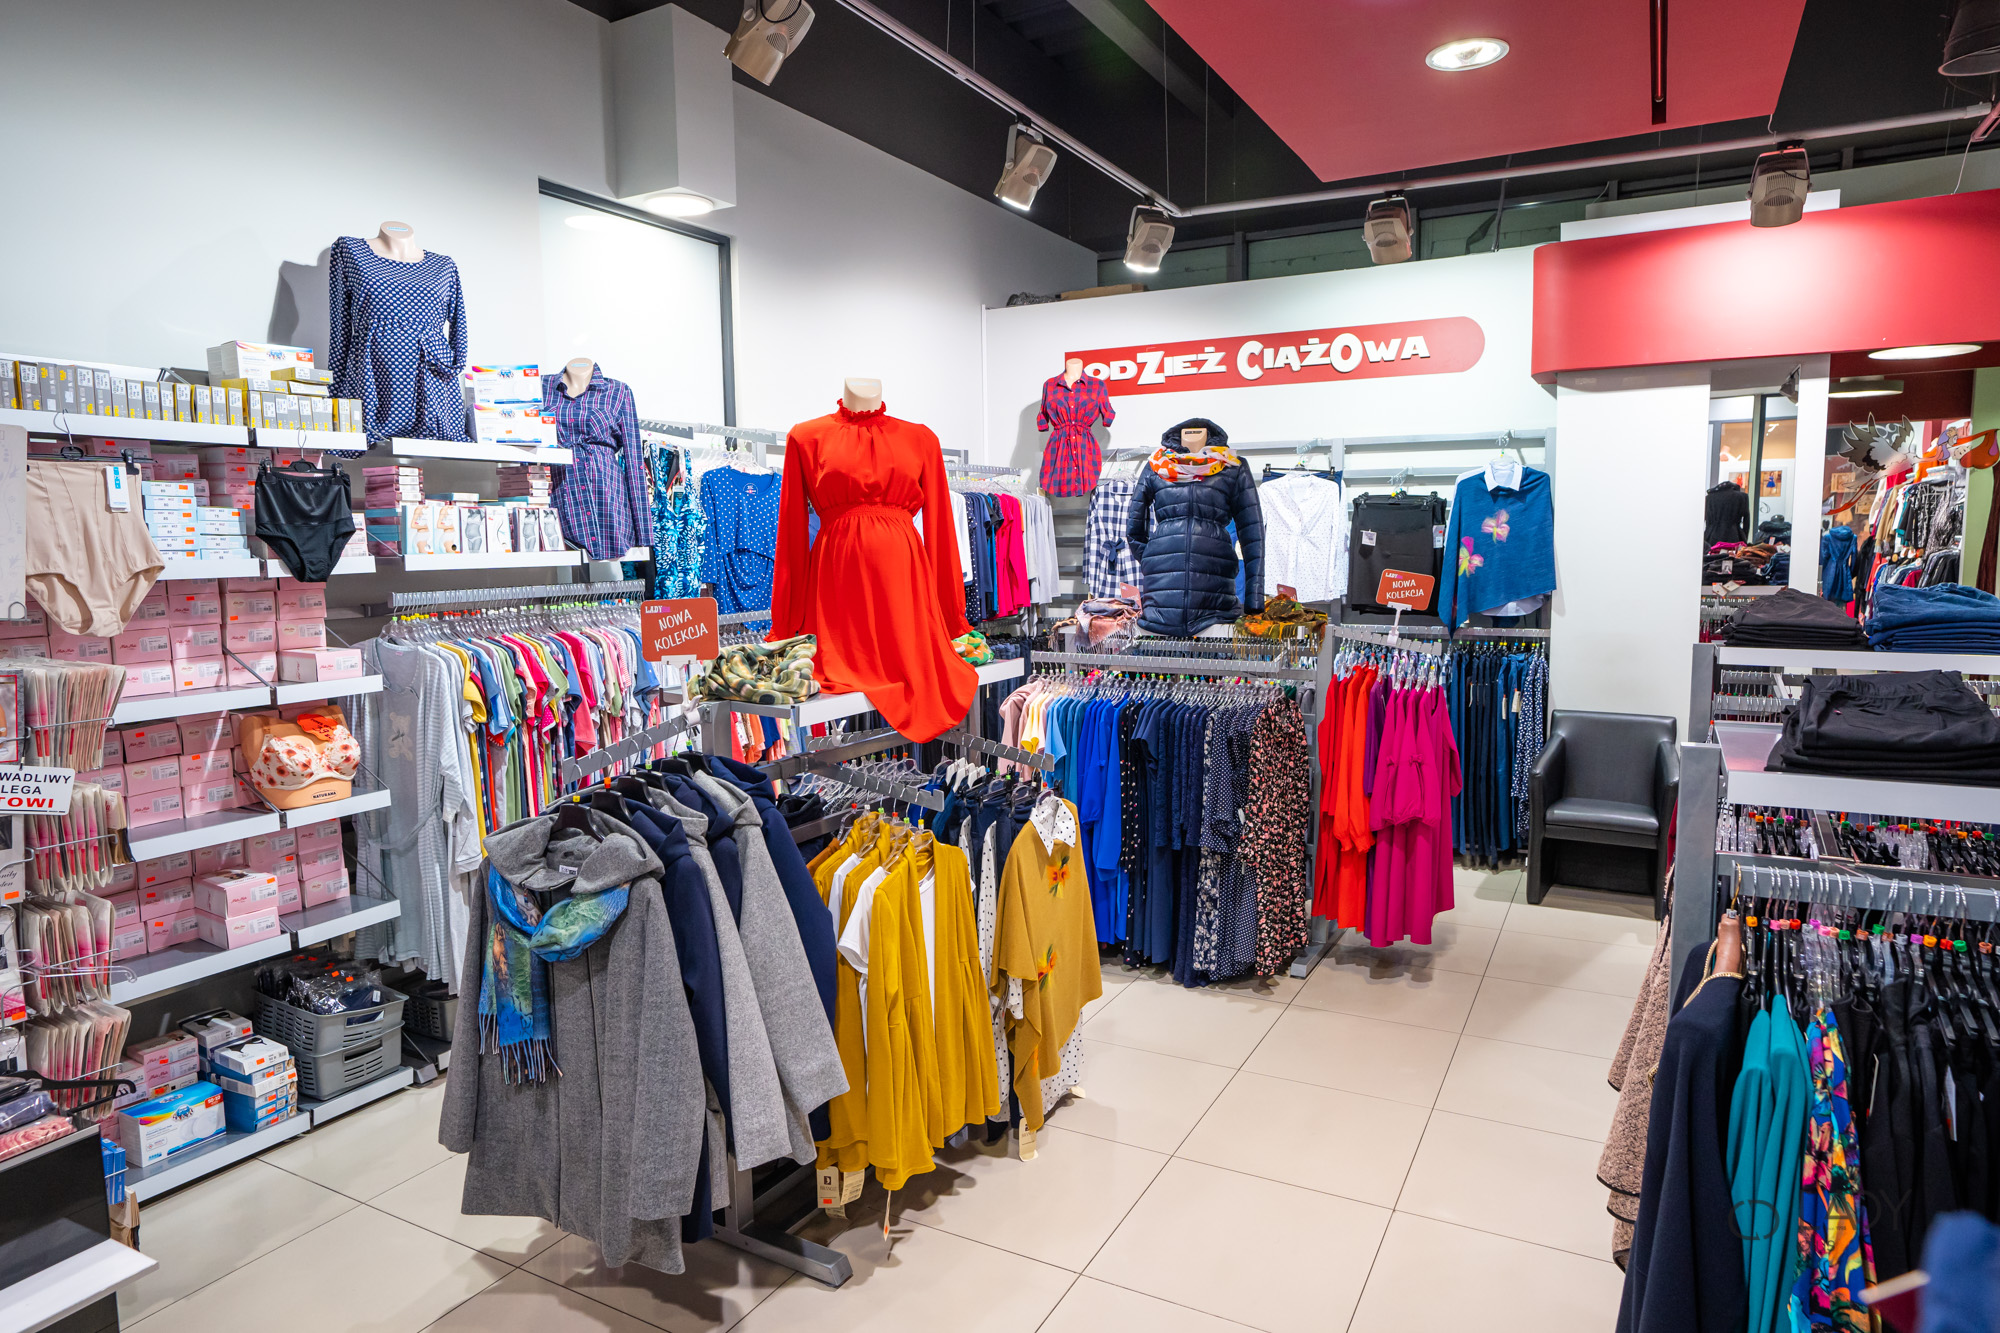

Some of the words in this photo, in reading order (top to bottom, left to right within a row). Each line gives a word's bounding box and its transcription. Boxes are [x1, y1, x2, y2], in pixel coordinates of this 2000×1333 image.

[1083, 346, 1227, 386] ODZIEŻ
[1236, 332, 1432, 381] CIĄŻOWA
[1386, 588, 1424, 600] KOLEKCJA
[1392, 579, 1416, 589] NOWA
[658, 609, 693, 632] NOWA
[654, 622, 709, 652] KOLEKCJA
